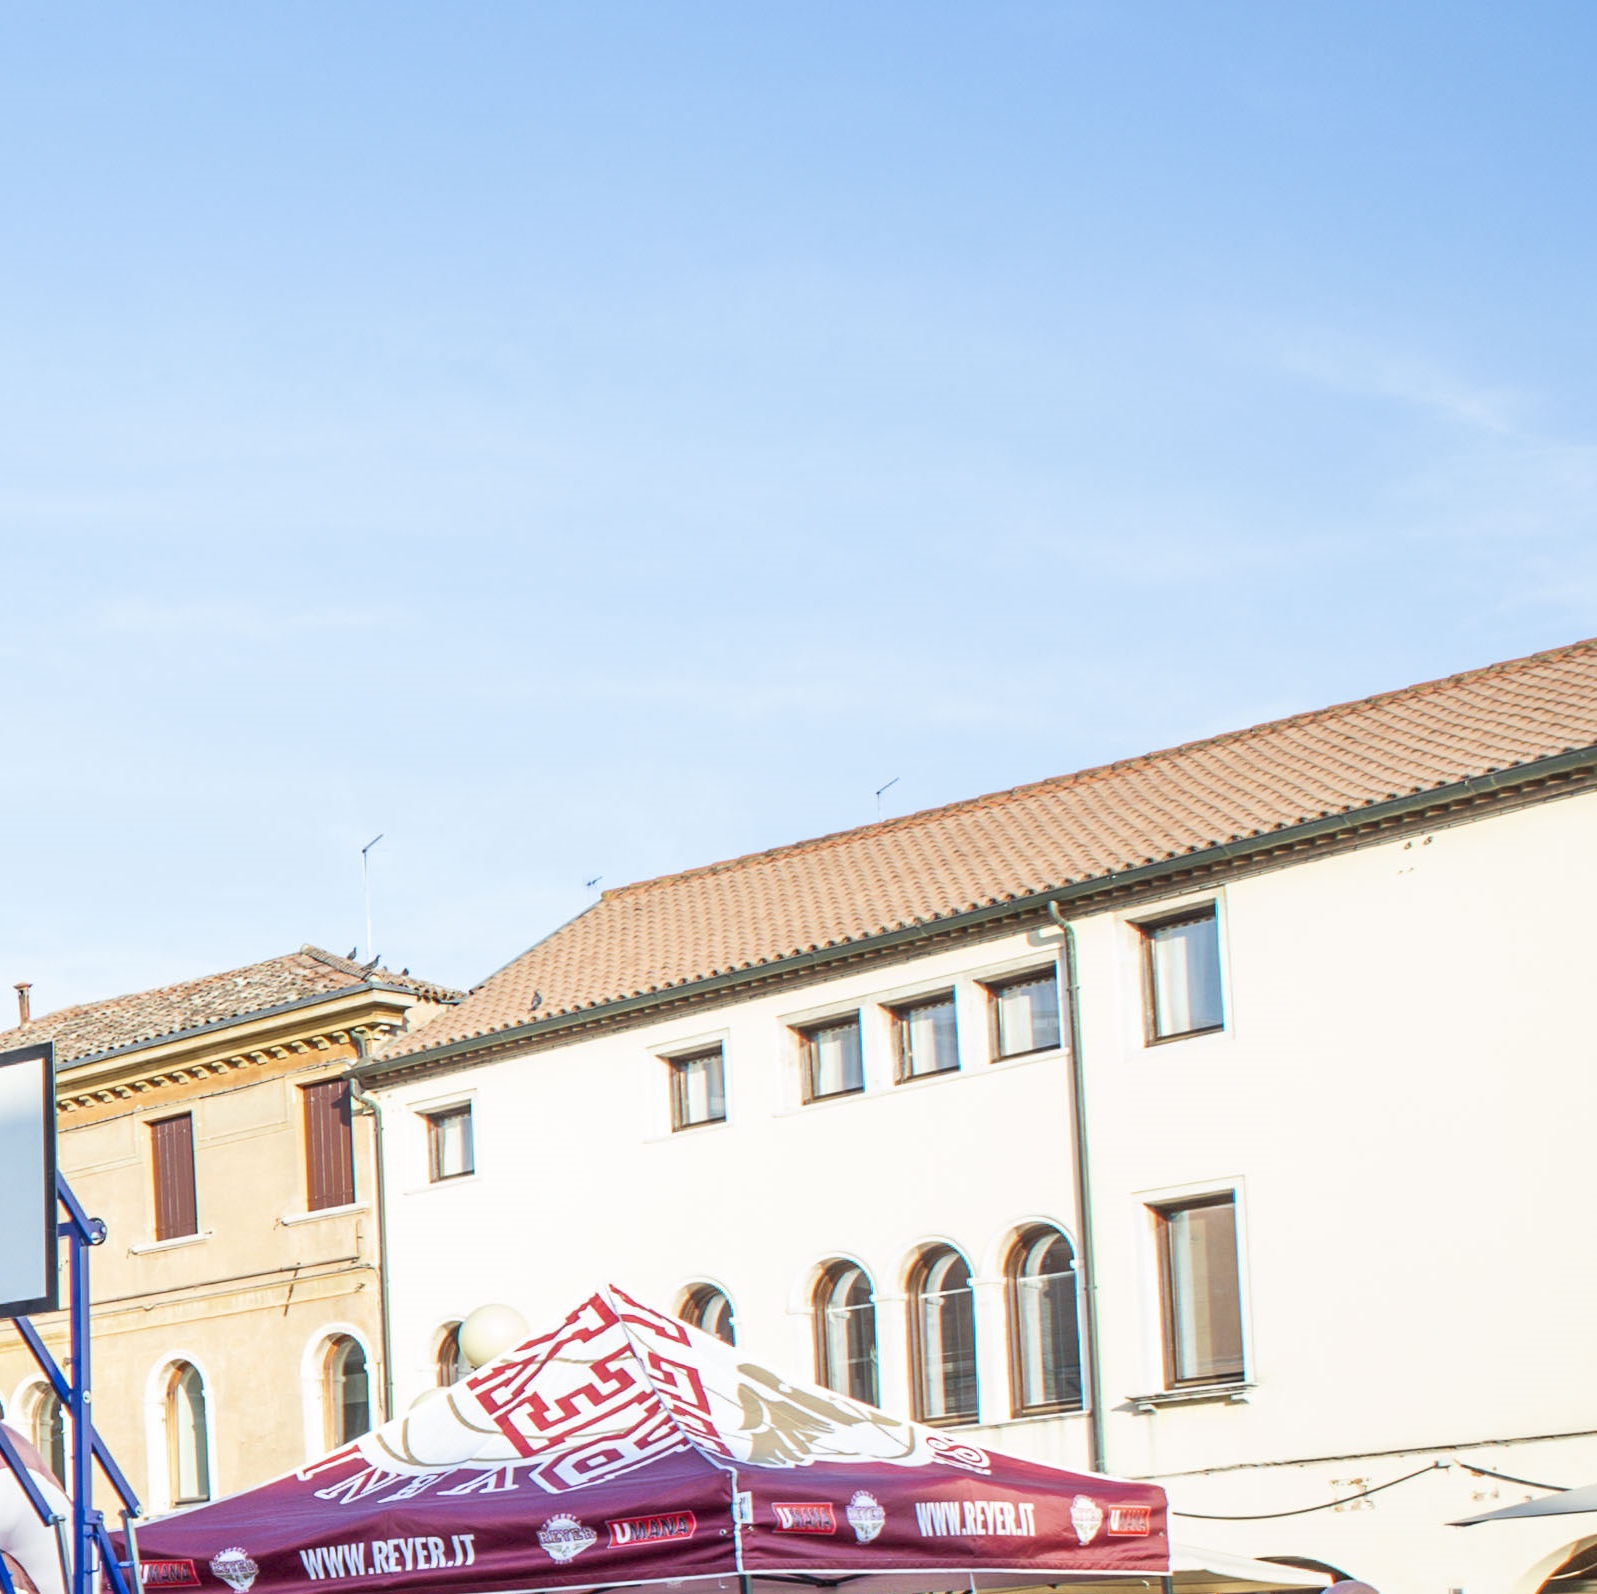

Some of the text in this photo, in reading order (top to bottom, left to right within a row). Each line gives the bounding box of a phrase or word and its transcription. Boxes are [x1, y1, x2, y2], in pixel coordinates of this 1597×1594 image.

[612, 1516, 690, 1544] UMANA
[915, 1500, 1036, 1537] WWW.REYER.IT
[299, 1534, 477, 1581] WWW.REYER.IT
